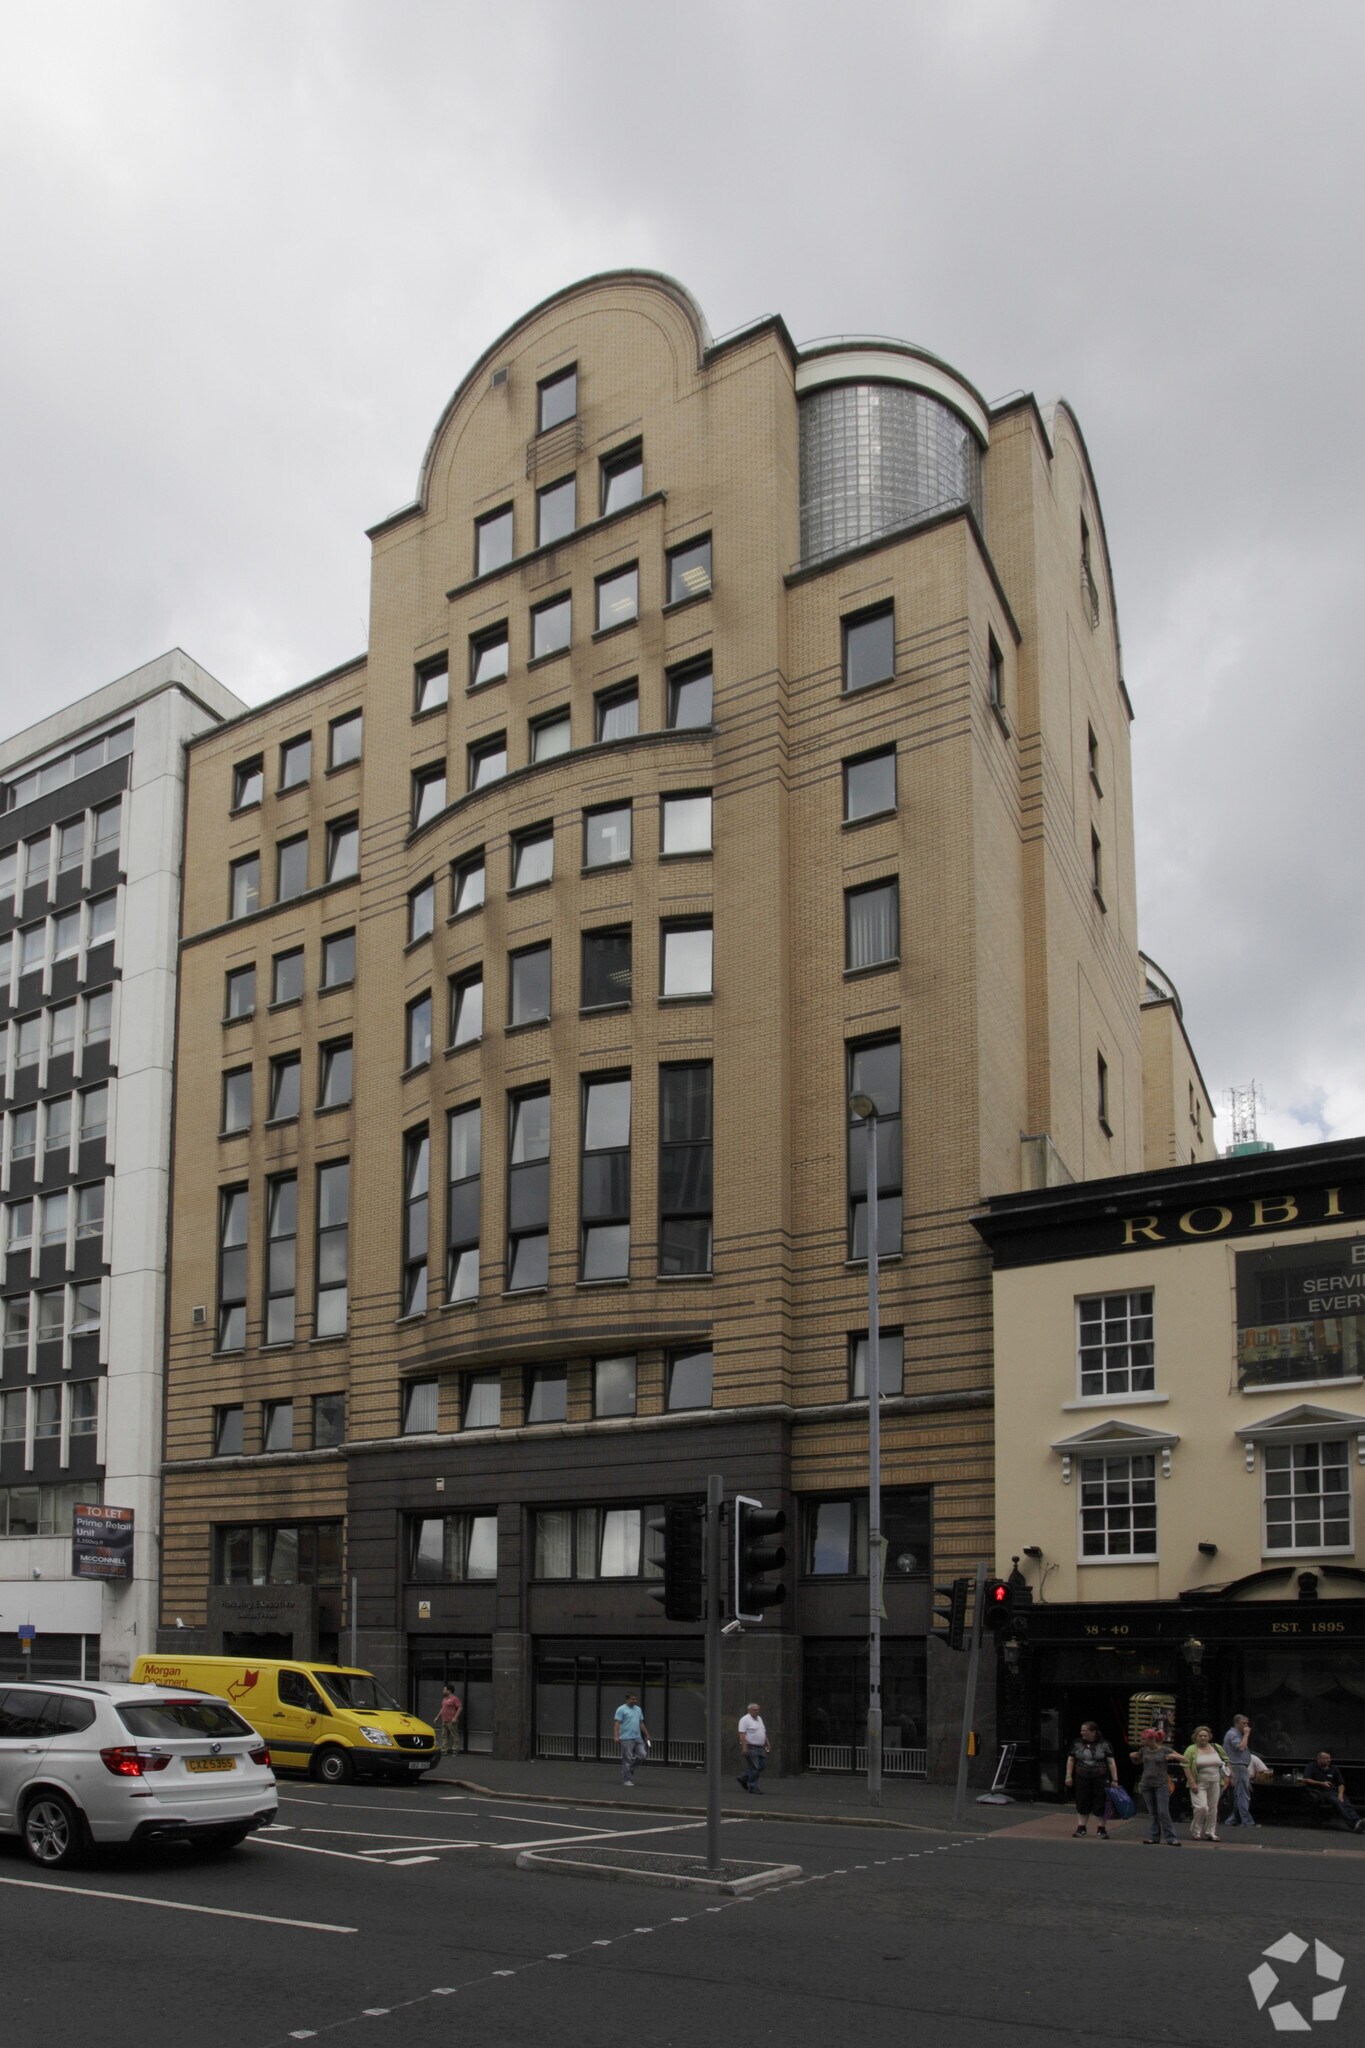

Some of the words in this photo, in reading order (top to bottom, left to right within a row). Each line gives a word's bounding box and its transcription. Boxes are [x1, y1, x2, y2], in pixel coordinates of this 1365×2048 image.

[1303, 1273, 1365, 1293] SERVI
[86, 1506, 101, 1516] TO
[105, 1509, 123, 1519] LET
[76, 1518, 103, 1528] Prime
[105, 1521, 131, 1531] Retail
[76, 1528, 95, 1536] Unit
[80, 1554, 127, 1565] McCONNELL
[1311, 1622, 1345, 1633] 1895
[145, 1664, 181, 1677] Morgan
[189, 1760, 210, 1770] CXZ
[210, 1758, 233, 1769] 5355
